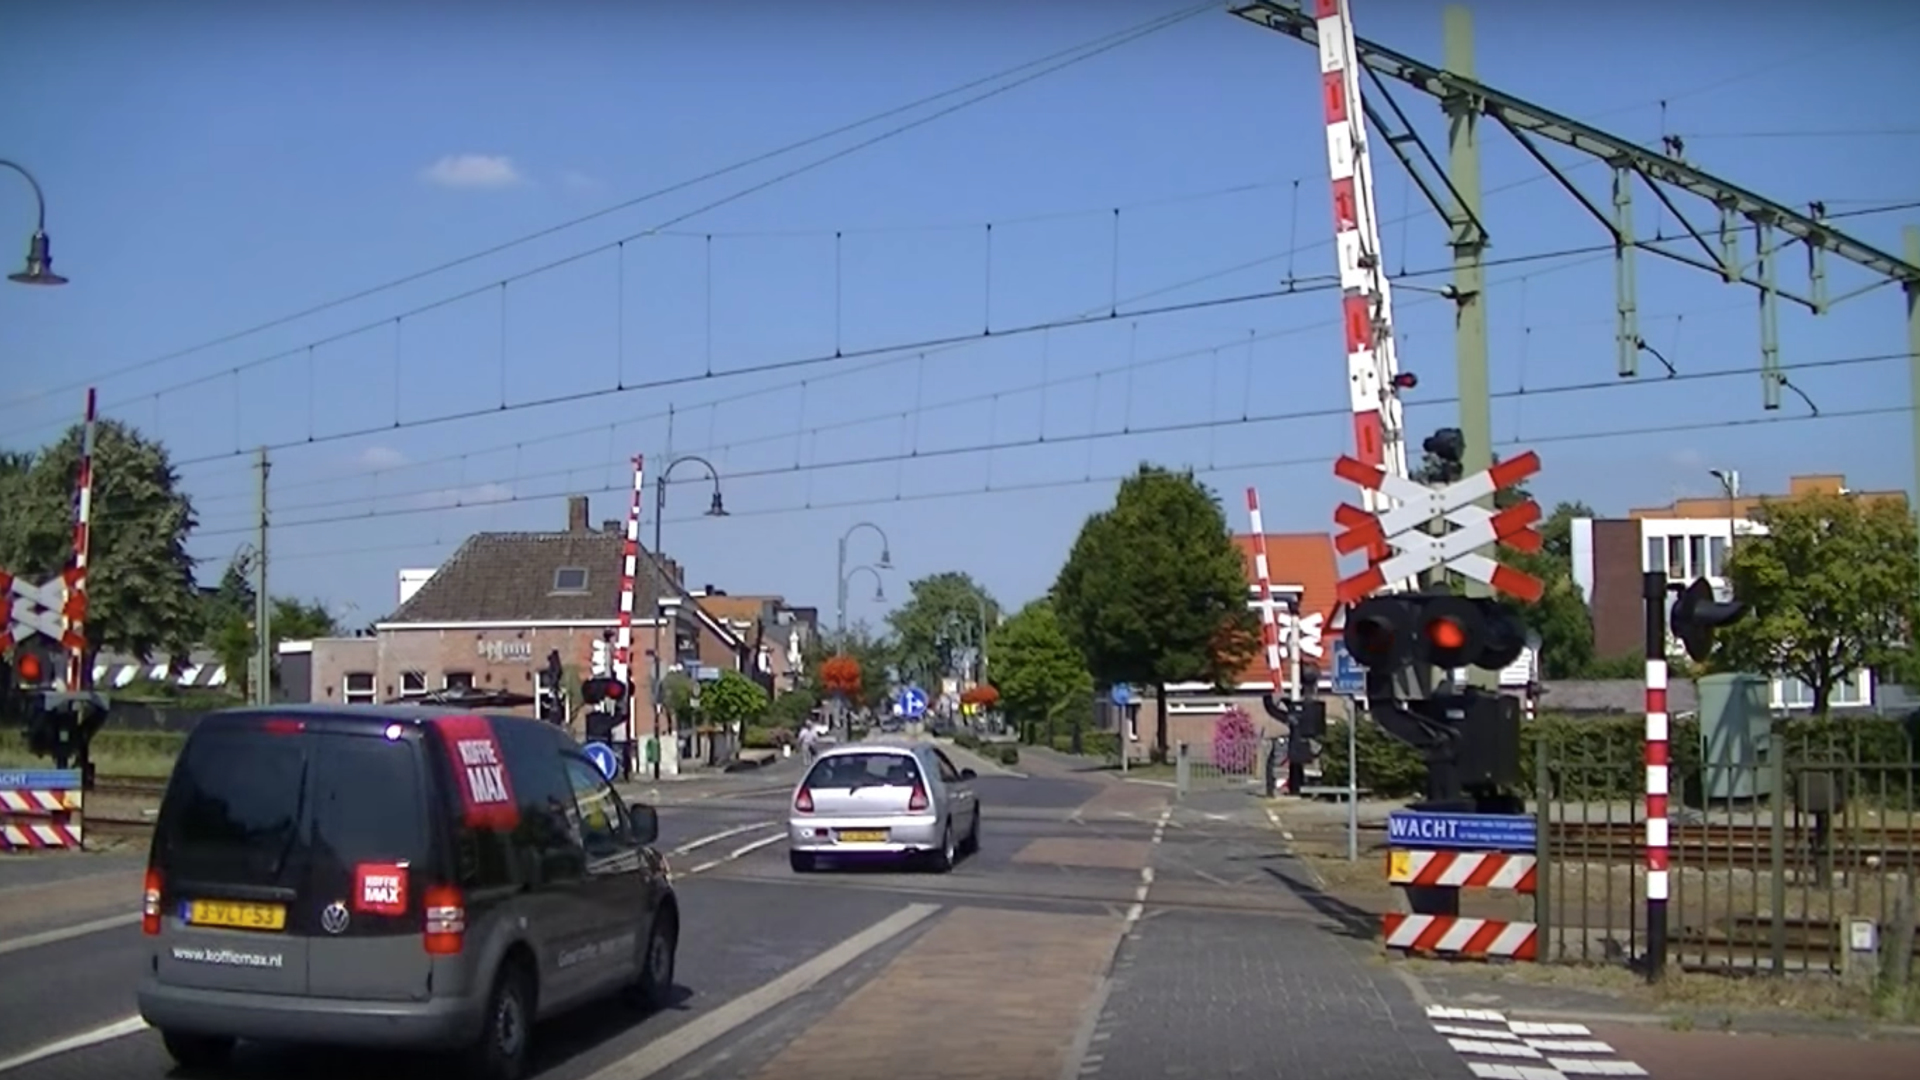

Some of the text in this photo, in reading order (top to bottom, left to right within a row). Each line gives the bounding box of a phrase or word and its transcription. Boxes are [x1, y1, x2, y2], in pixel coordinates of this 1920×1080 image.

[457, 740, 498, 765] KOFFIE
[466, 764, 509, 803] MAX
[1390, 818, 1458, 838] WACHT
[364, 887, 400, 903] MAX
[172, 947, 283, 968] www.koffiemax.nl
